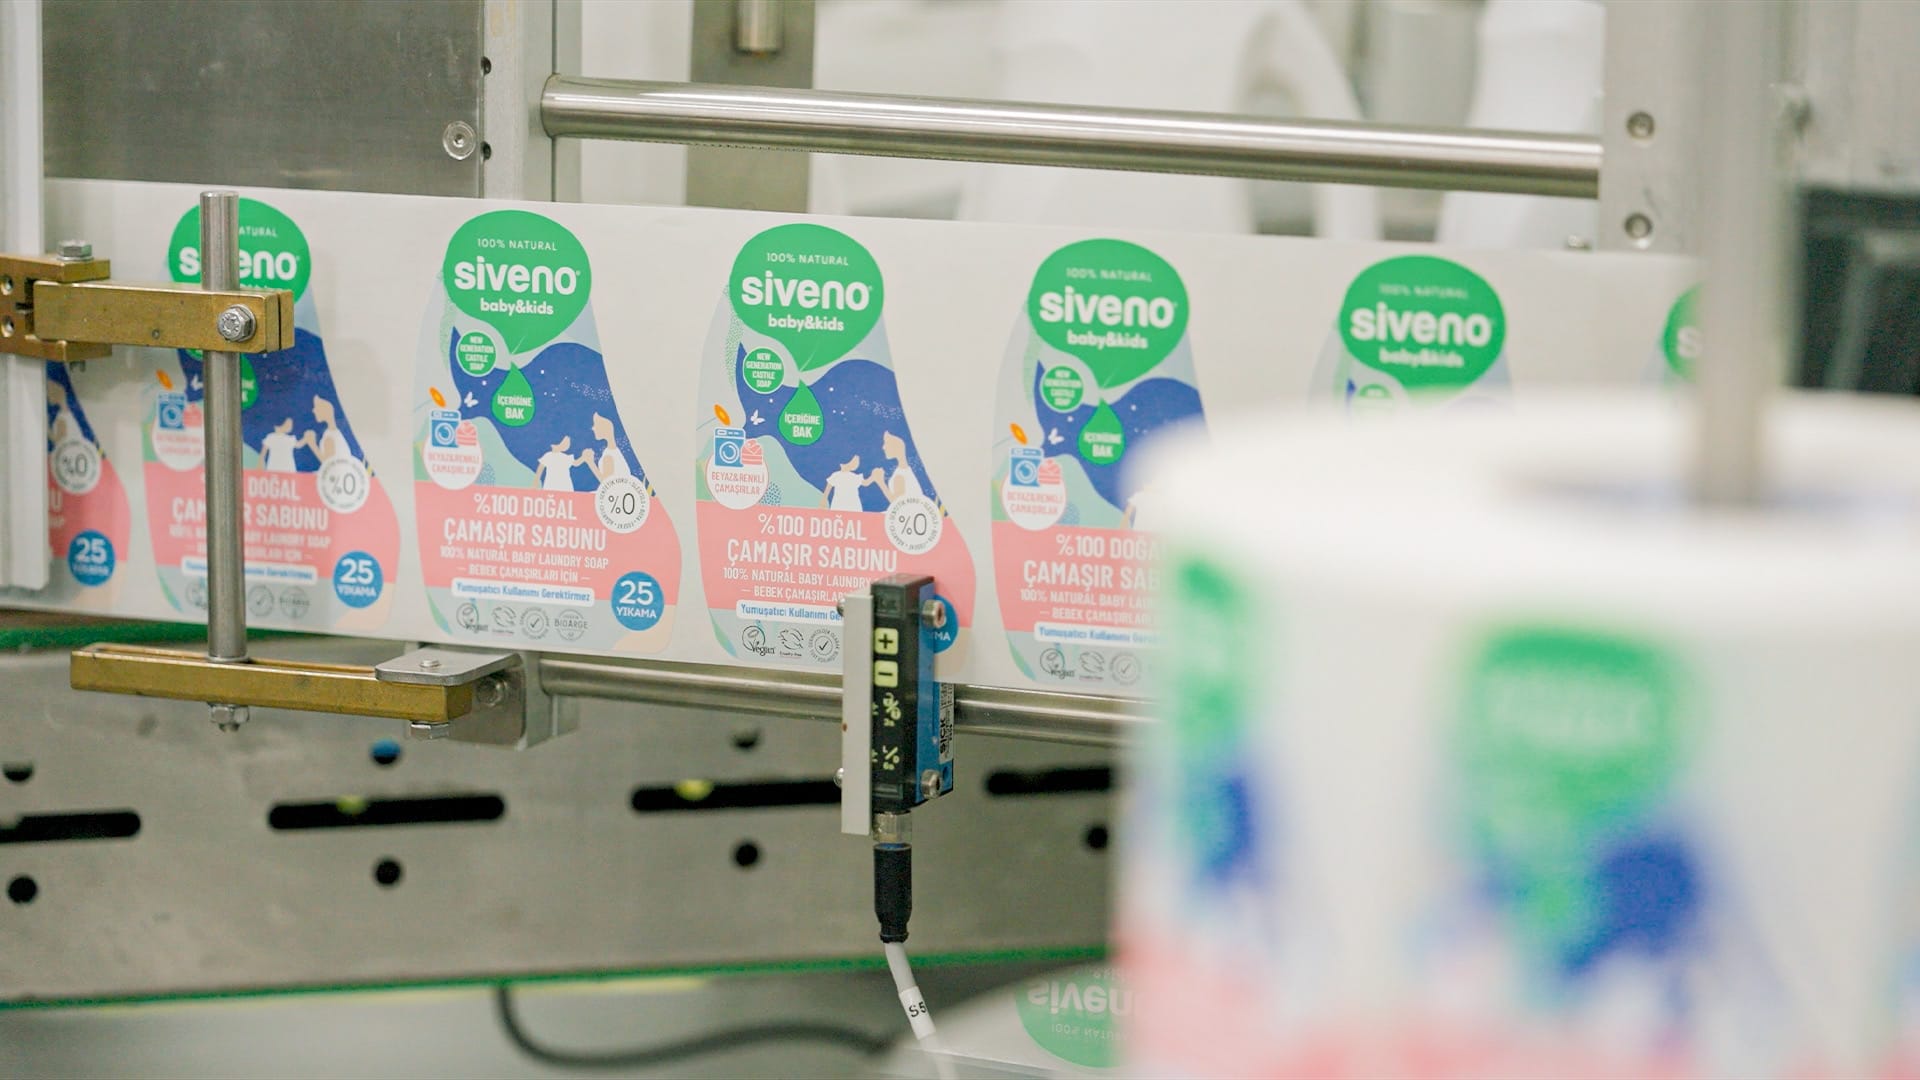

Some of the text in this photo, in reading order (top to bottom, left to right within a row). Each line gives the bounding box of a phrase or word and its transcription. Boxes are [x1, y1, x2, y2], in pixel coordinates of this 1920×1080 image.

[239, 226, 278, 238] ATURAL
[477, 238, 558, 251] 100% NATURAL
[179, 246, 298, 280] seno
[767, 252, 849, 266] 100% NATURAL
[454, 256, 577, 295] siveno
[741, 270, 870, 311] siveno
[480, 298, 554, 316] baby&kids
[1039, 286, 1175, 328] siveno
[768, 314, 844, 332] baby&kids
[1350, 302, 1492, 347] siveno
[1067, 330, 1148, 350] baby&kids
[504, 407, 525, 420] BAK
[792, 425, 812, 438] BAK
[474, 493, 577, 521] %100 DOĞAL
[608, 493, 635, 515] %0
[256, 504, 328, 530] SABUNU
[758, 512, 867, 541] %100 DOĞAL
[898, 513, 927, 536] %0
[444, 519, 607, 551] ÇAMAŞIR SABUNU
[1056, 534, 1105, 558] %100
[76, 538, 108, 564] 25
[467, 548, 510, 562] NATURAL
[512, 552, 536, 565] BABY
[539, 553, 582, 568] LAUNDRY
[584, 556, 608, 569] SOAP
[728, 539, 898, 572] ÇAMAŞIR SABUNU
[340, 560, 374, 584] 25
[469, 564, 497, 576] BEBEK
[724, 568, 748, 580] 100%
[752, 568, 796, 584] NATURAL
[798, 572, 824, 586] BABY
[826, 574, 871, 590] LAUNDRY
[1024, 560, 1114, 592] ÇAMAŞIR
[619, 580, 654, 605] 25
[754, 586, 846, 604] BEBEK ÇAMAŞIRLAR
[616, 607, 656, 619] YIKAMA
[741, 604, 786, 618] Yumuşatıcı
[788, 607, 828, 620] Kullanımı
[908, 1001, 928, 1018] S5
